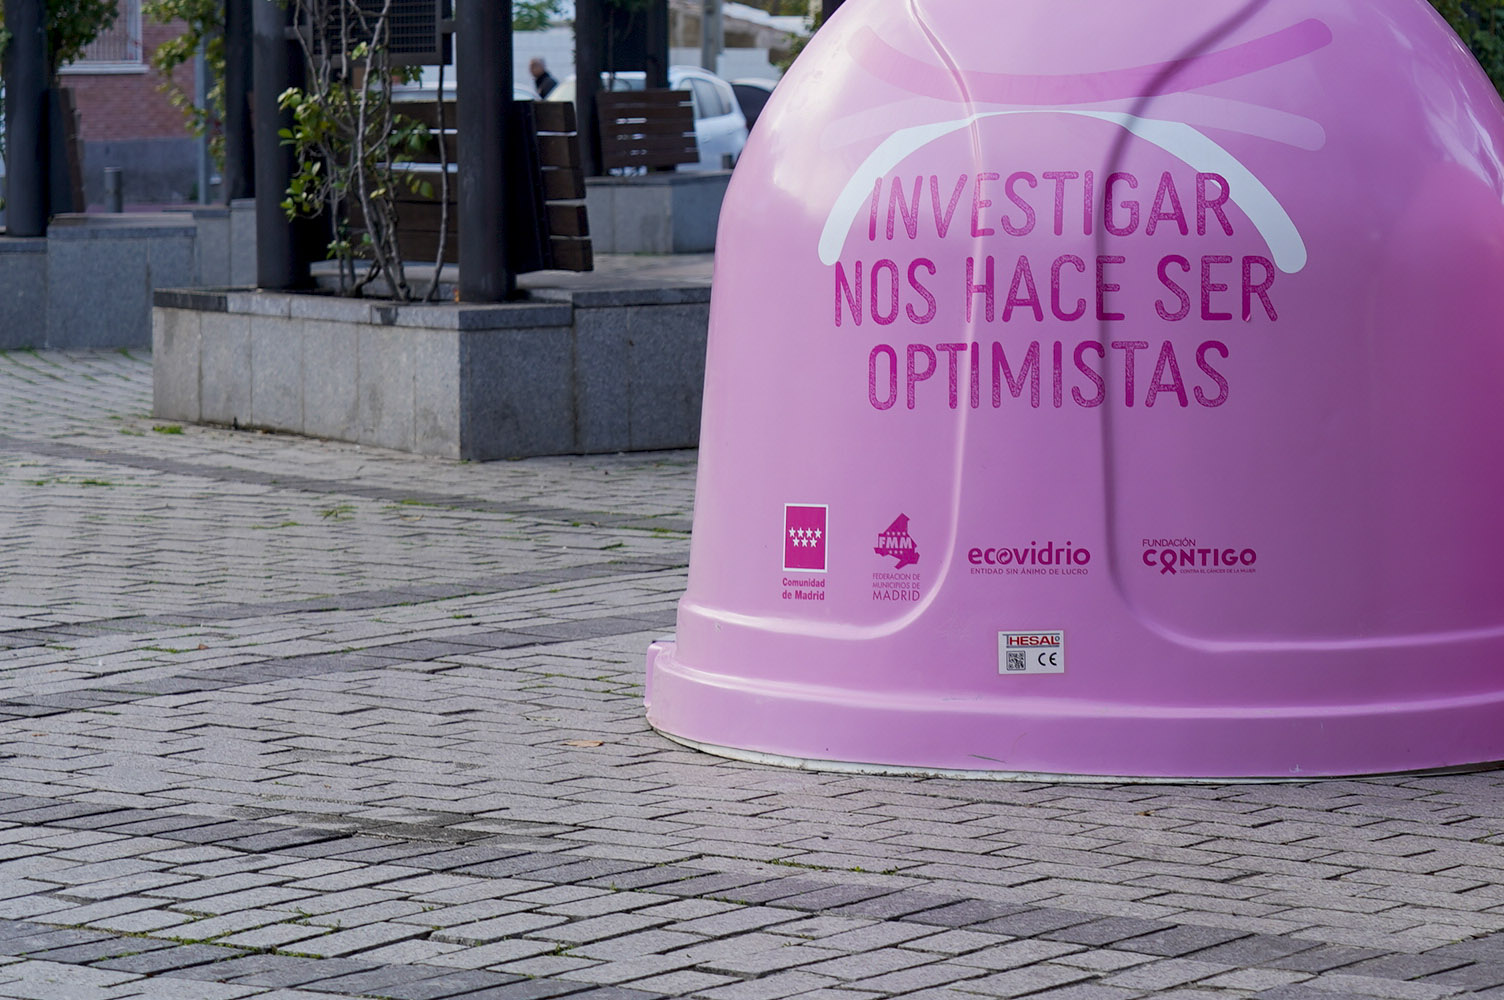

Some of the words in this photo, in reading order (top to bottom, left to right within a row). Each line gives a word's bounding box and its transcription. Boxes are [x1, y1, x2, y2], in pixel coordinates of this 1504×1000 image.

[867, 170, 1235, 241] INVESTIGAR
[833, 256, 938, 328] NOS
[965, 254, 1126, 323] HACE
[1153, 254, 1279, 323] SER
[867, 339, 1230, 411] OPTIMISTAS
[879, 536, 913, 549] FMM
[1142, 537, 1196, 547] FUNDACIÓN
[967, 540, 1091, 565] ecovidrio
[1142, 548, 1257, 575] CONTIGO
[912, 573, 921, 581] DE
[970, 567, 1004, 575] ENTIDAD
[782, 577, 826, 588] Comunidad
[872, 581, 911, 590] MUNICIPIOS
[781, 590, 793, 600] de
[794, 590, 825, 601] Madrid
[872, 589, 921, 601] MADRID
